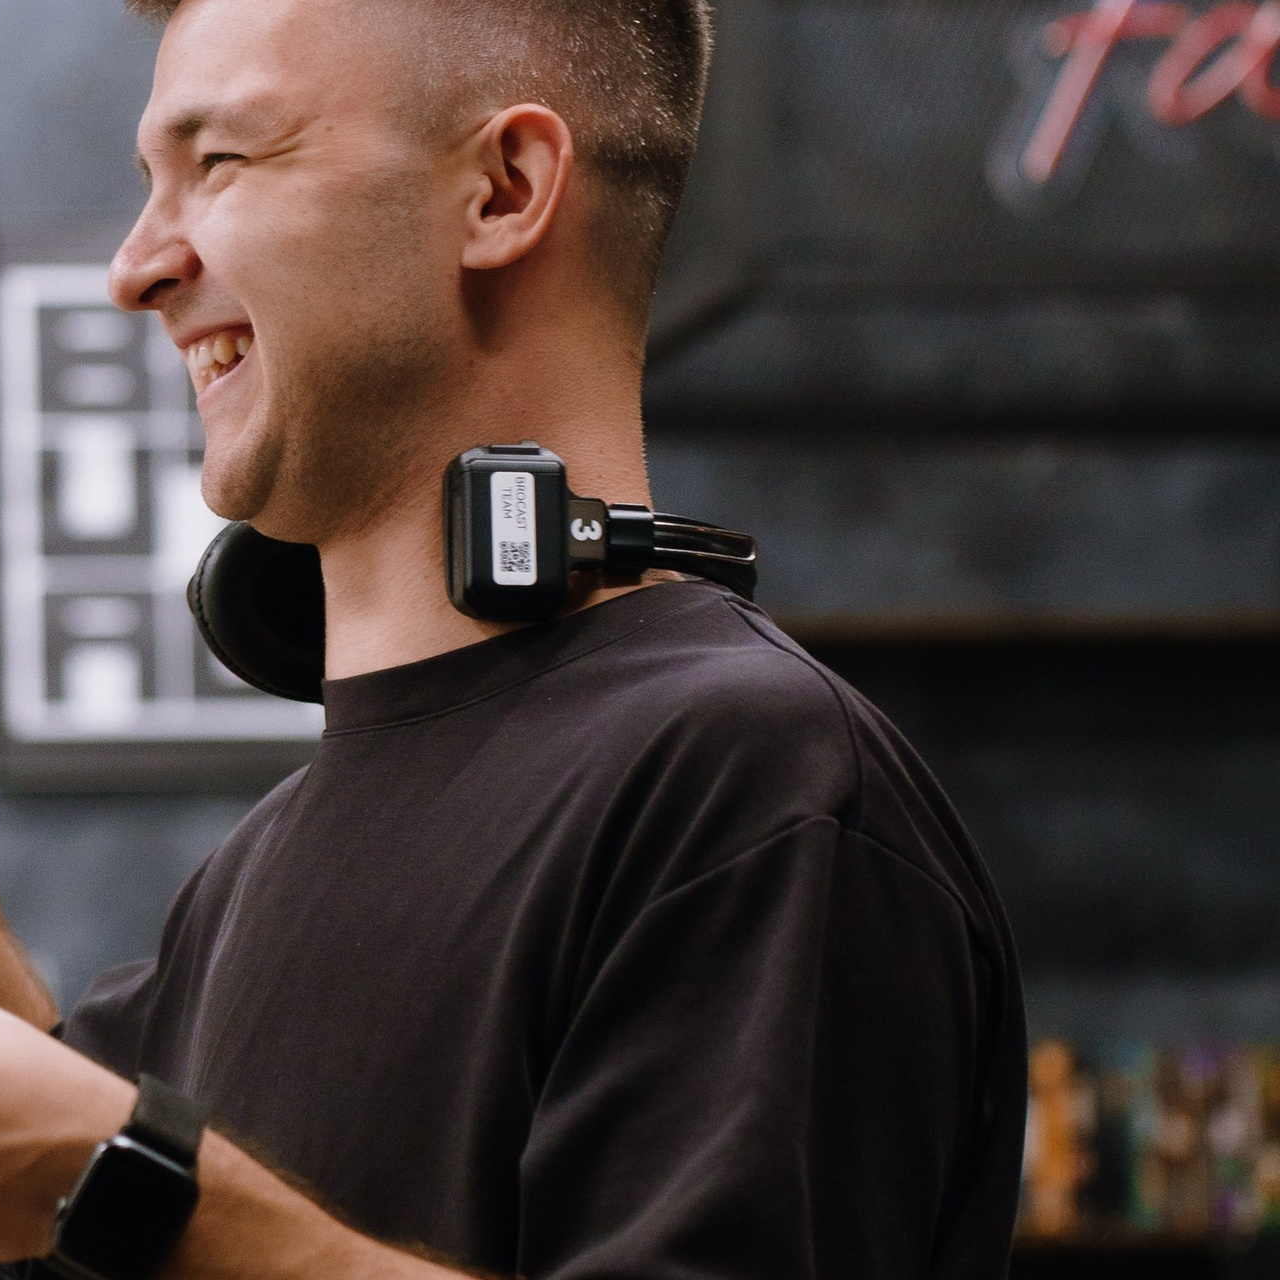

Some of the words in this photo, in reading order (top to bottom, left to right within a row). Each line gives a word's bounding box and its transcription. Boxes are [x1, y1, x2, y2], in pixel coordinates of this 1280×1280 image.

[502, 486, 513, 519] TEAM
[515, 475, 528, 531] BROCAST
[571, 518, 602, 541] 3
